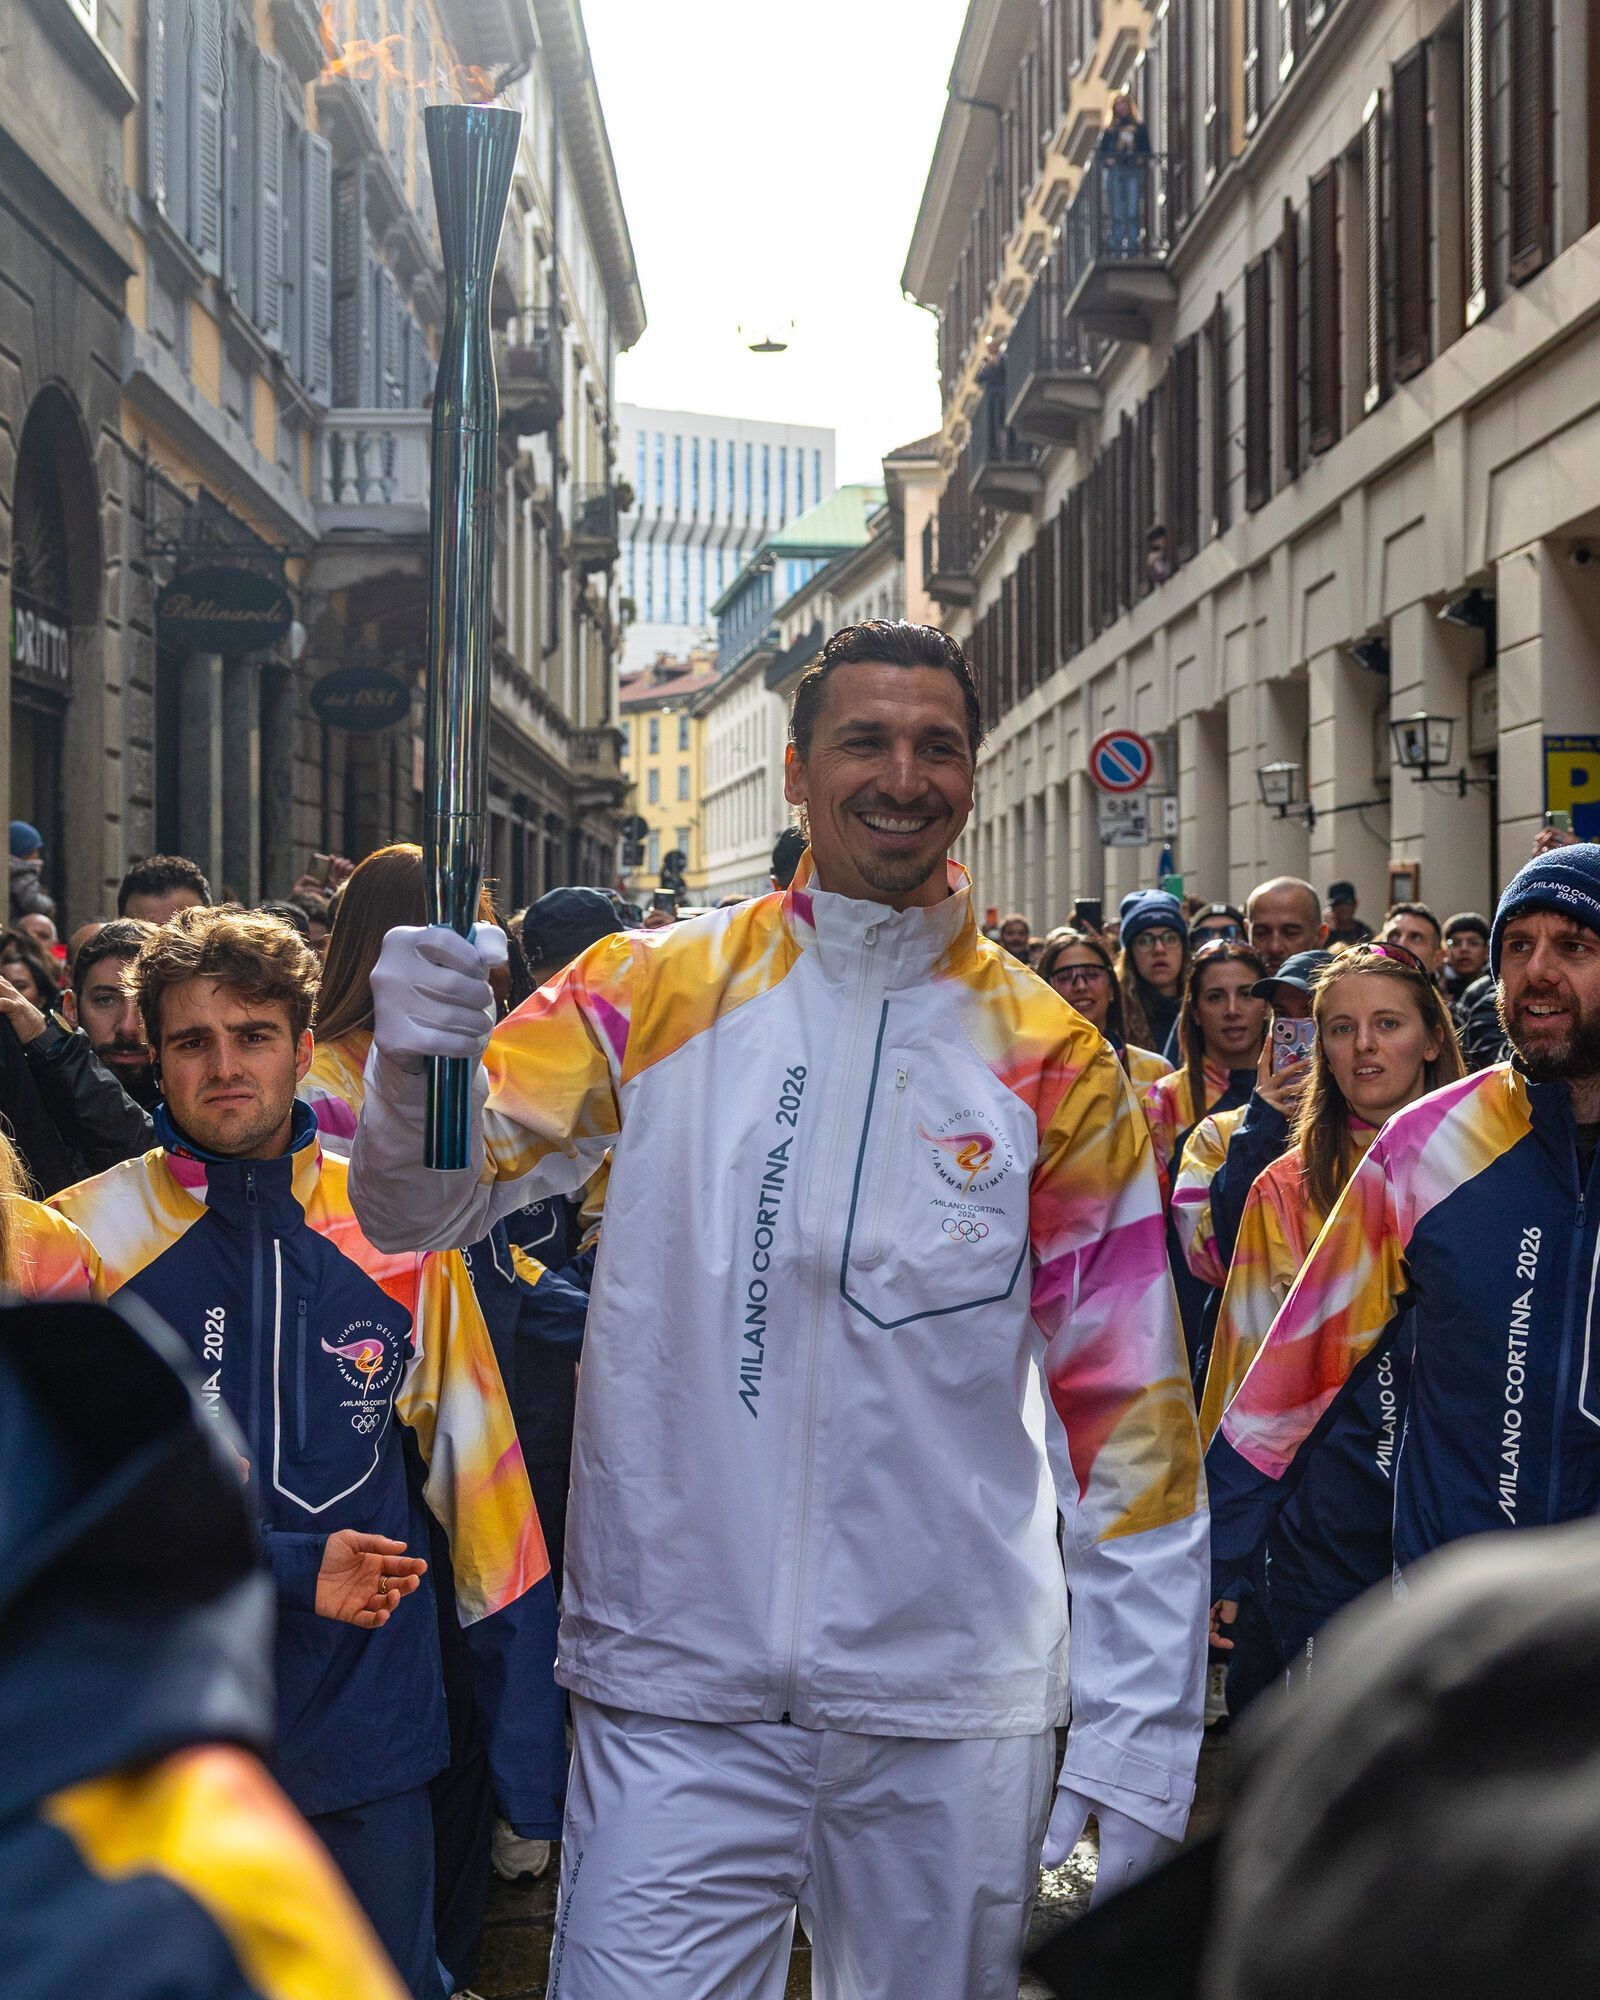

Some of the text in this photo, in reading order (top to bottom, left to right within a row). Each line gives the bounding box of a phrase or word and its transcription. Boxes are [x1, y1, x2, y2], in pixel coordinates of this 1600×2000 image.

[1525, 881, 1571, 893] MILANO
[1556, 891, 1578, 904] 2026
[938, 1109, 985, 1133] VIAGGIO
[932, 1149, 1014, 1192] FIAMMA OLIMPICA
[930, 1199, 1006, 1216] MILANO CORTINA
[957, 1210, 976, 1219] 2026
[738, 1064, 808, 1419] MILANO CORTINA 2026
[203, 1306, 226, 1361] 2026
[337, 1320, 398, 1348] VIAGGIO DELLA
[336, 1352, 399, 1390] FIAMMA OLIMPICA
[1498, 1226, 1543, 1525] MILANO CORTINA 2026
[1376, 1390, 1397, 1479] MILANO
[557, 1889, 575, 1964] CORTINA
[570, 1851, 584, 1886] 2026
